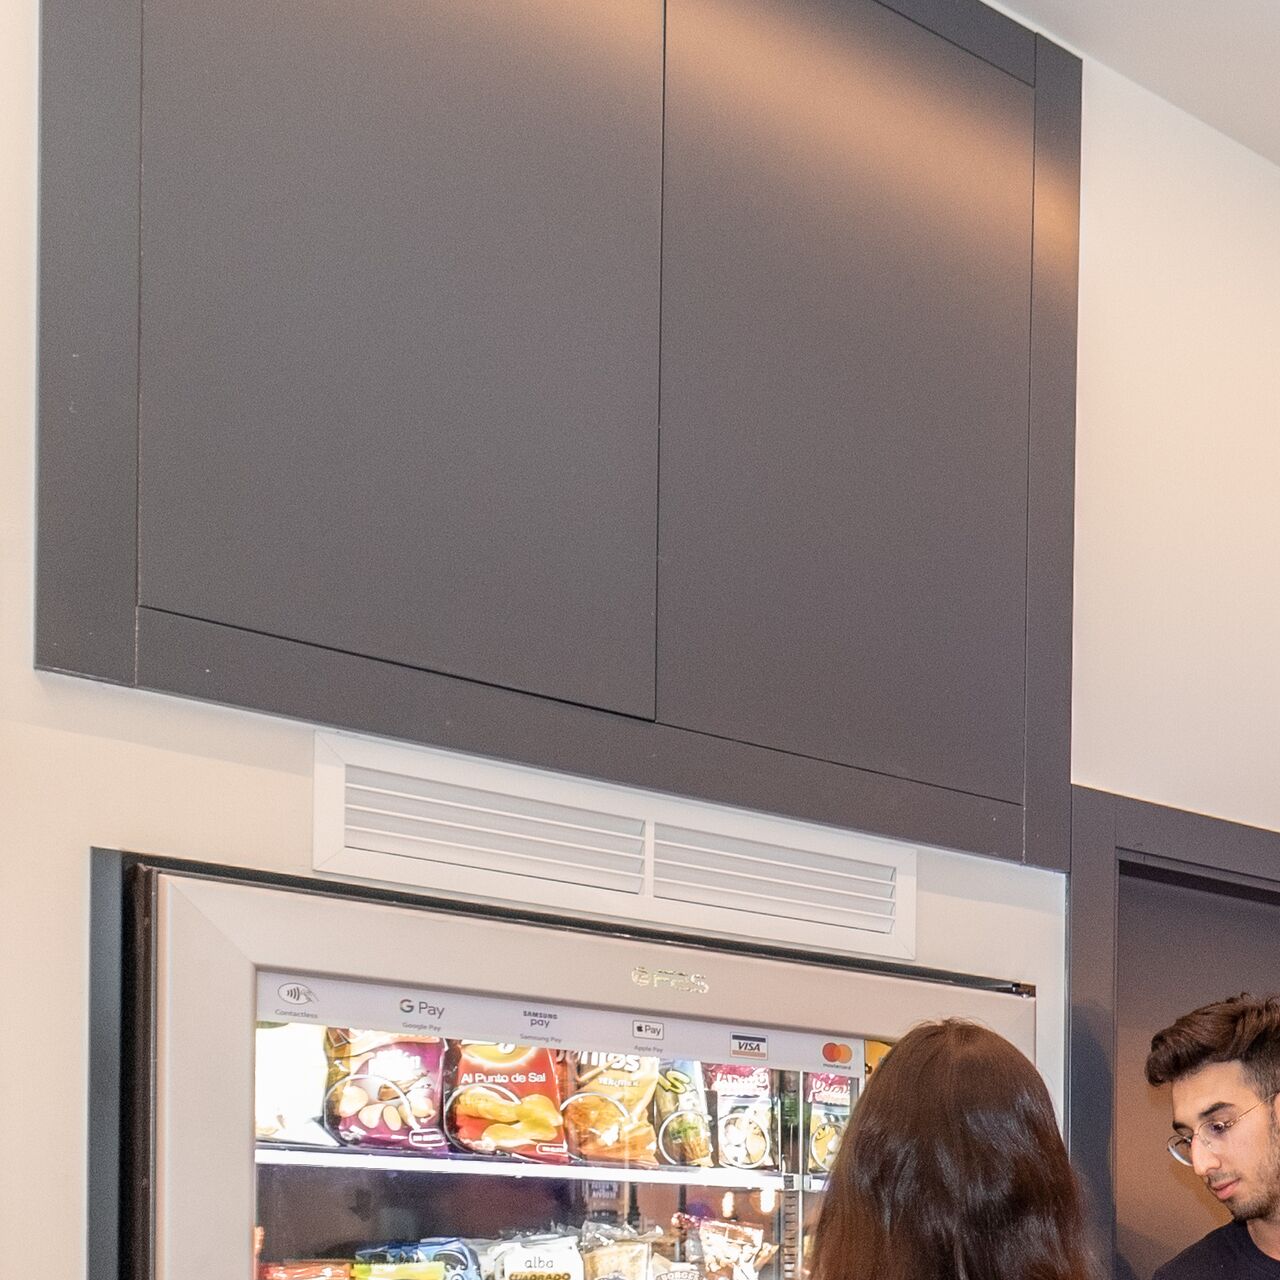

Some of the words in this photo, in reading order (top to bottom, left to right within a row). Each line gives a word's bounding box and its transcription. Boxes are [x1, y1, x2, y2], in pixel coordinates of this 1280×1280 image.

[274, 1008, 319, 1020] Contactless
[418, 1001, 446, 1020] Pay
[523, 1010, 558, 1020] SAMSUNG
[402, 1021, 427, 1032] Google
[428, 1023, 442, 1033] Pay
[530, 1018, 550, 1029] pay
[644, 1024, 662, 1036] Pay
[520, 1033, 550, 1043] Samsung
[550, 1036, 562, 1044] Pay
[634, 1044, 651, 1053] Apple
[651, 1046, 663, 1054] Pay
[737, 1041, 761, 1052] VISA
[460, 1073, 474, 1084] Al
[475, 1072, 509, 1084] Punto
[510, 1072, 526, 1083] de
[528, 1072, 546, 1083] Sal
[524, 1256, 554, 1269] alba
[661, 1272, 700, 1280] BORGES
